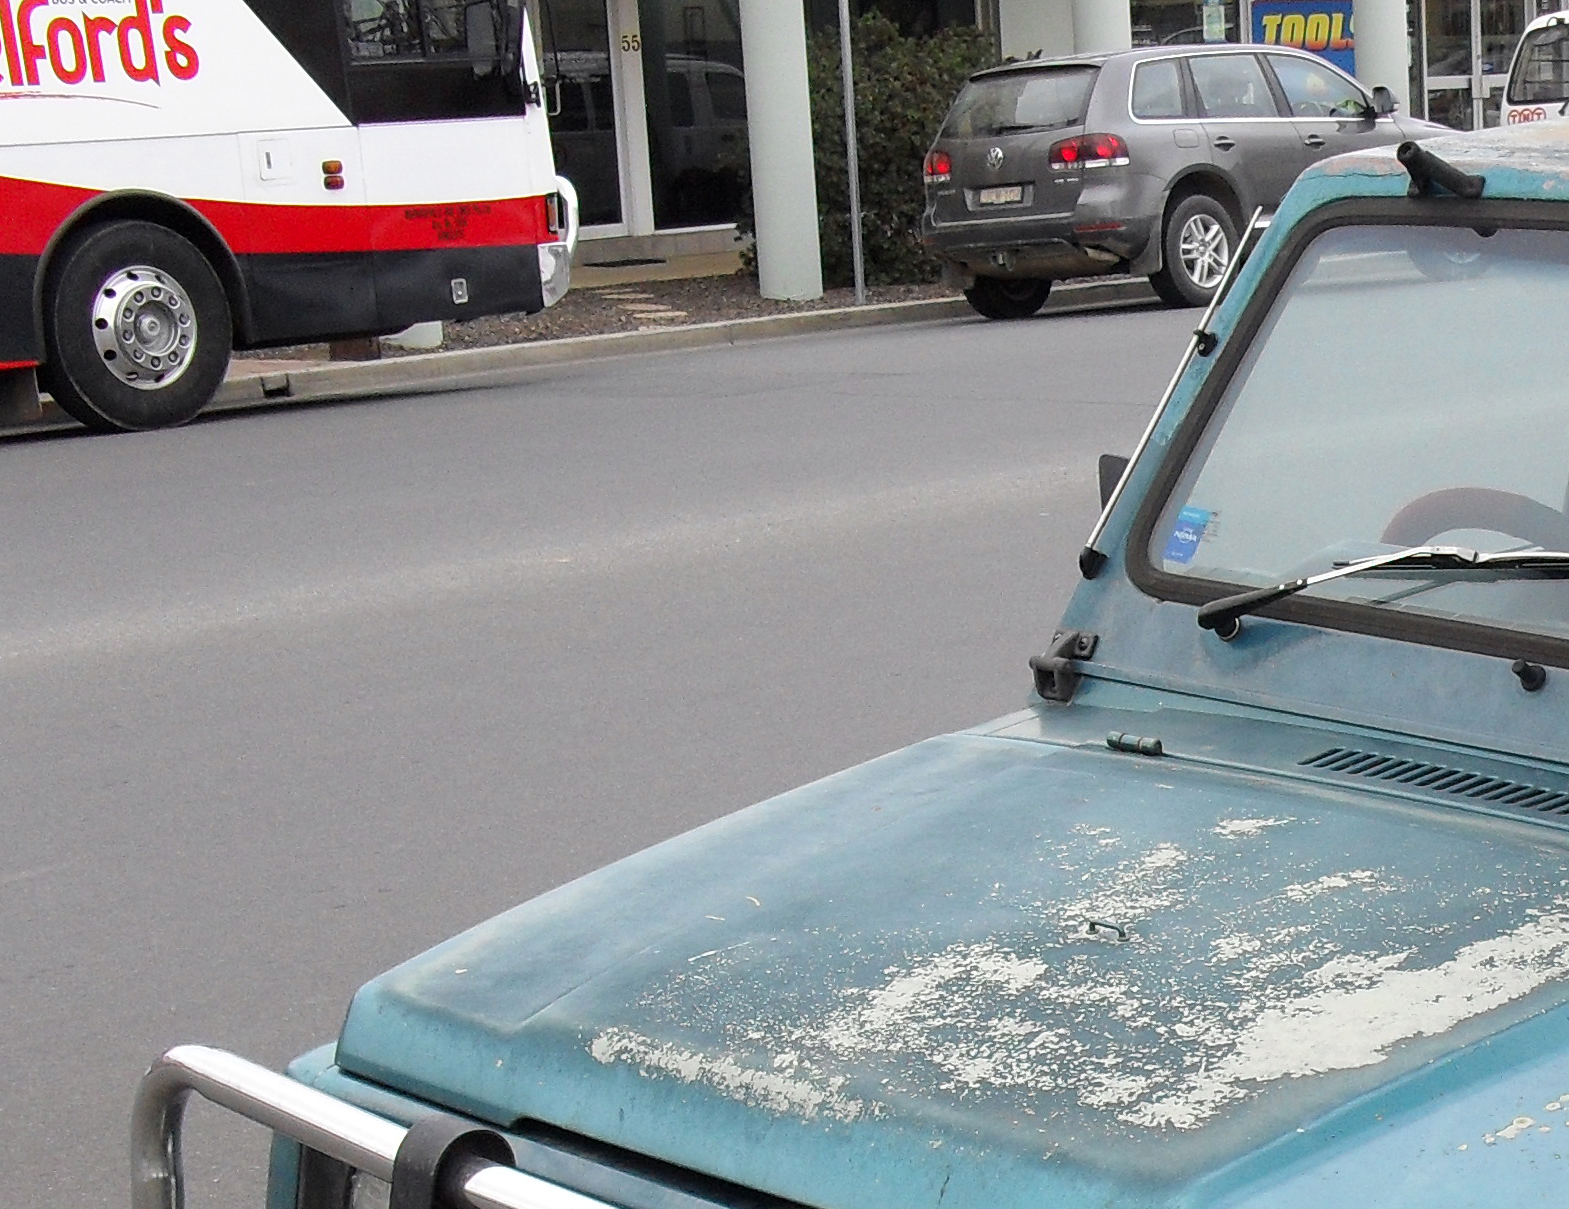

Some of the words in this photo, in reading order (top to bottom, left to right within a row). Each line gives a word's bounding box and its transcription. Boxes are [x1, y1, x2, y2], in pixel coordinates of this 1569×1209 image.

[0, 0, 200, 87] lford's
[621, 34, 640, 52] 55
[1262, 13, 1354, 50] TOOL
[1508, 107, 1547, 125] TNT
